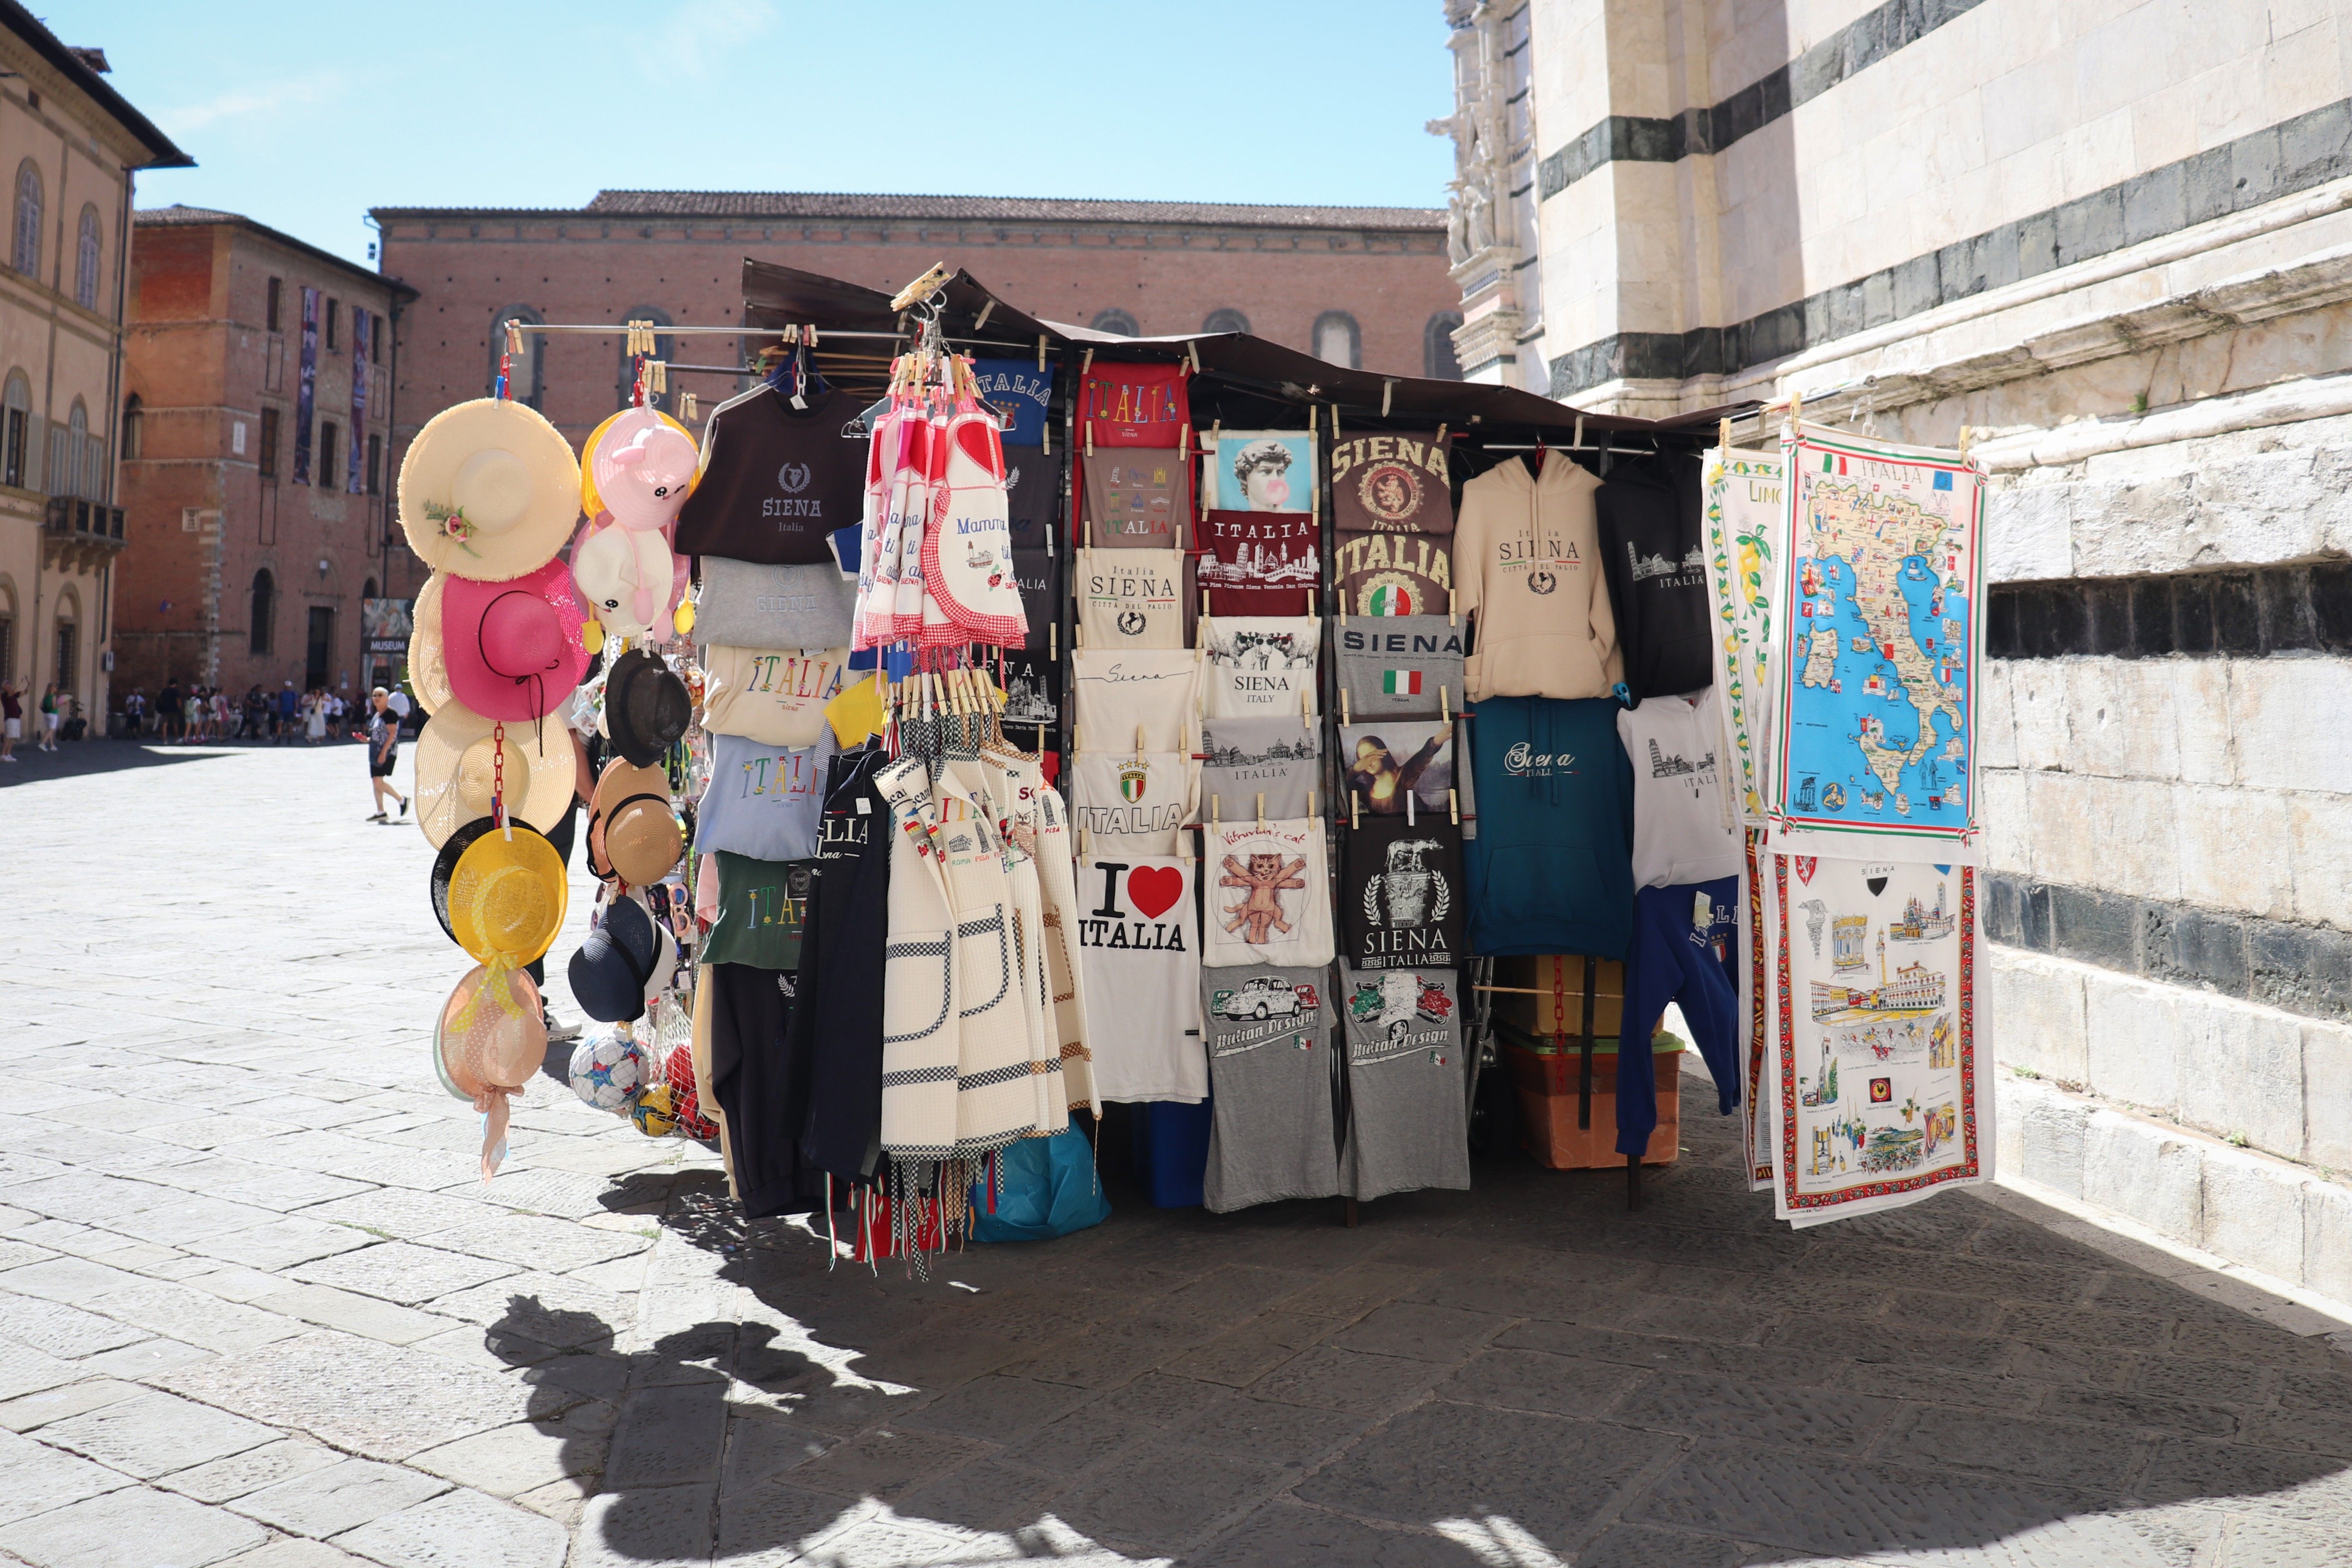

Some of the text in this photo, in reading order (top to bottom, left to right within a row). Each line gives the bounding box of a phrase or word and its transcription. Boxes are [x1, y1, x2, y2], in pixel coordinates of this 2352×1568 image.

[1086, 379, 1177, 423] ITALIA
[1332, 436, 1450, 491] SIENA
[1862, 460, 1922, 484] ITALIA
[763, 498, 821, 517] SIENA
[778, 522, 804, 532] Italia
[1106, 520, 1169, 534] ITALIA
[1214, 521, 1308, 539] ITALIA
[1519, 529, 1559, 537] Itia
[1113, 566, 1154, 575] Italia
[1334, 534, 1450, 592] ITALIA
[1091, 576, 1175, 597] SIENA
[1660, 575, 1703, 589] ITALIA
[756, 594, 817, 614] SIENA
[370, 640, 405, 651] MUSEUM
[1344, 631, 1463, 655] SIENA
[746, 656, 842, 700] ITALIA
[1099, 663, 1174, 683] Siena
[1234, 676, 1290, 691] SIENA
[1247, 694, 1275, 703] ITALY
[1504, 742, 1575, 773] Siena
[740, 755, 824, 799] ITALI
[1236, 768, 1288, 780] ITALIA
[1077, 804, 1183, 834] ITALIA
[1222, 823, 1306, 846] Vitruvian's cat
[951, 858, 971, 866] ROMA
[1861, 866, 1895, 876] SIENA
[1092, 862, 1129, 919] I
[1078, 919, 1187, 952] ITALIA
[1364, 928, 1448, 955] SIENA
[1383, 954, 1429, 968] ITALIA
[1215, 1011, 1315, 1049] Italian Design
[1351, 1028, 1448, 1059] Italian Design
